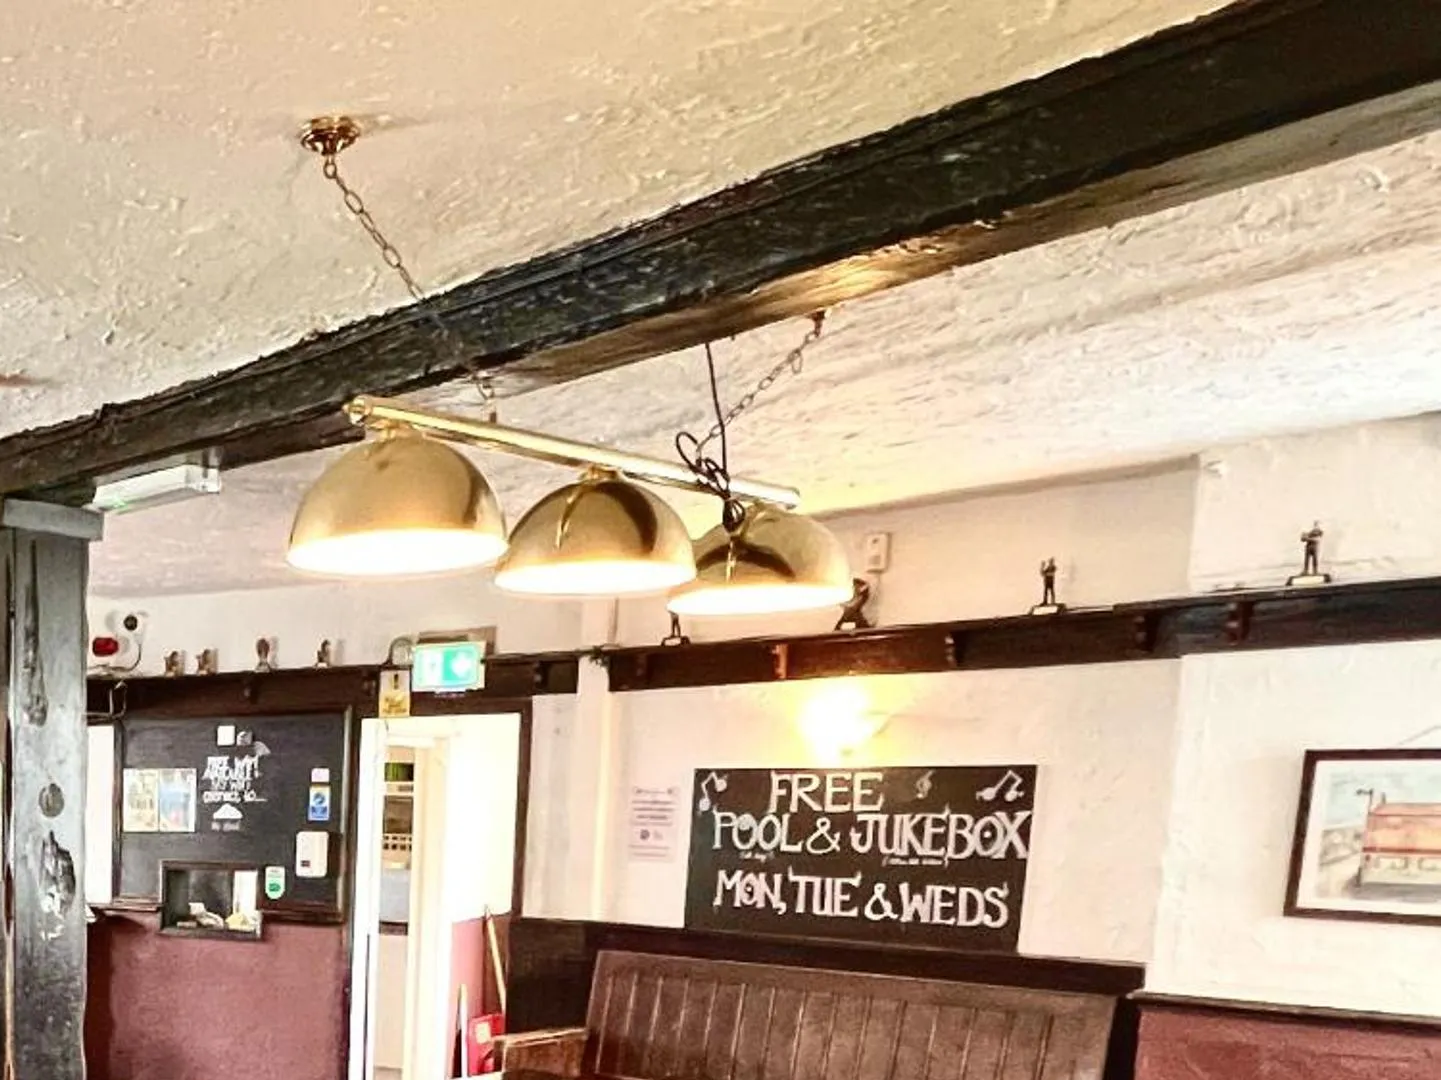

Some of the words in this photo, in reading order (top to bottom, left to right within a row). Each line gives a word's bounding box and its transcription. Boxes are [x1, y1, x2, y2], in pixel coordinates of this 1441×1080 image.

[769, 770, 885, 814] FREE
[711, 805, 803, 852] POOL
[806, 816, 841, 854] &
[850, 803, 1033, 860] JUKEBOX
[789, 866, 861, 917] TUE
[864, 882, 898, 921] &
[899, 881, 1009, 928] WEDS
